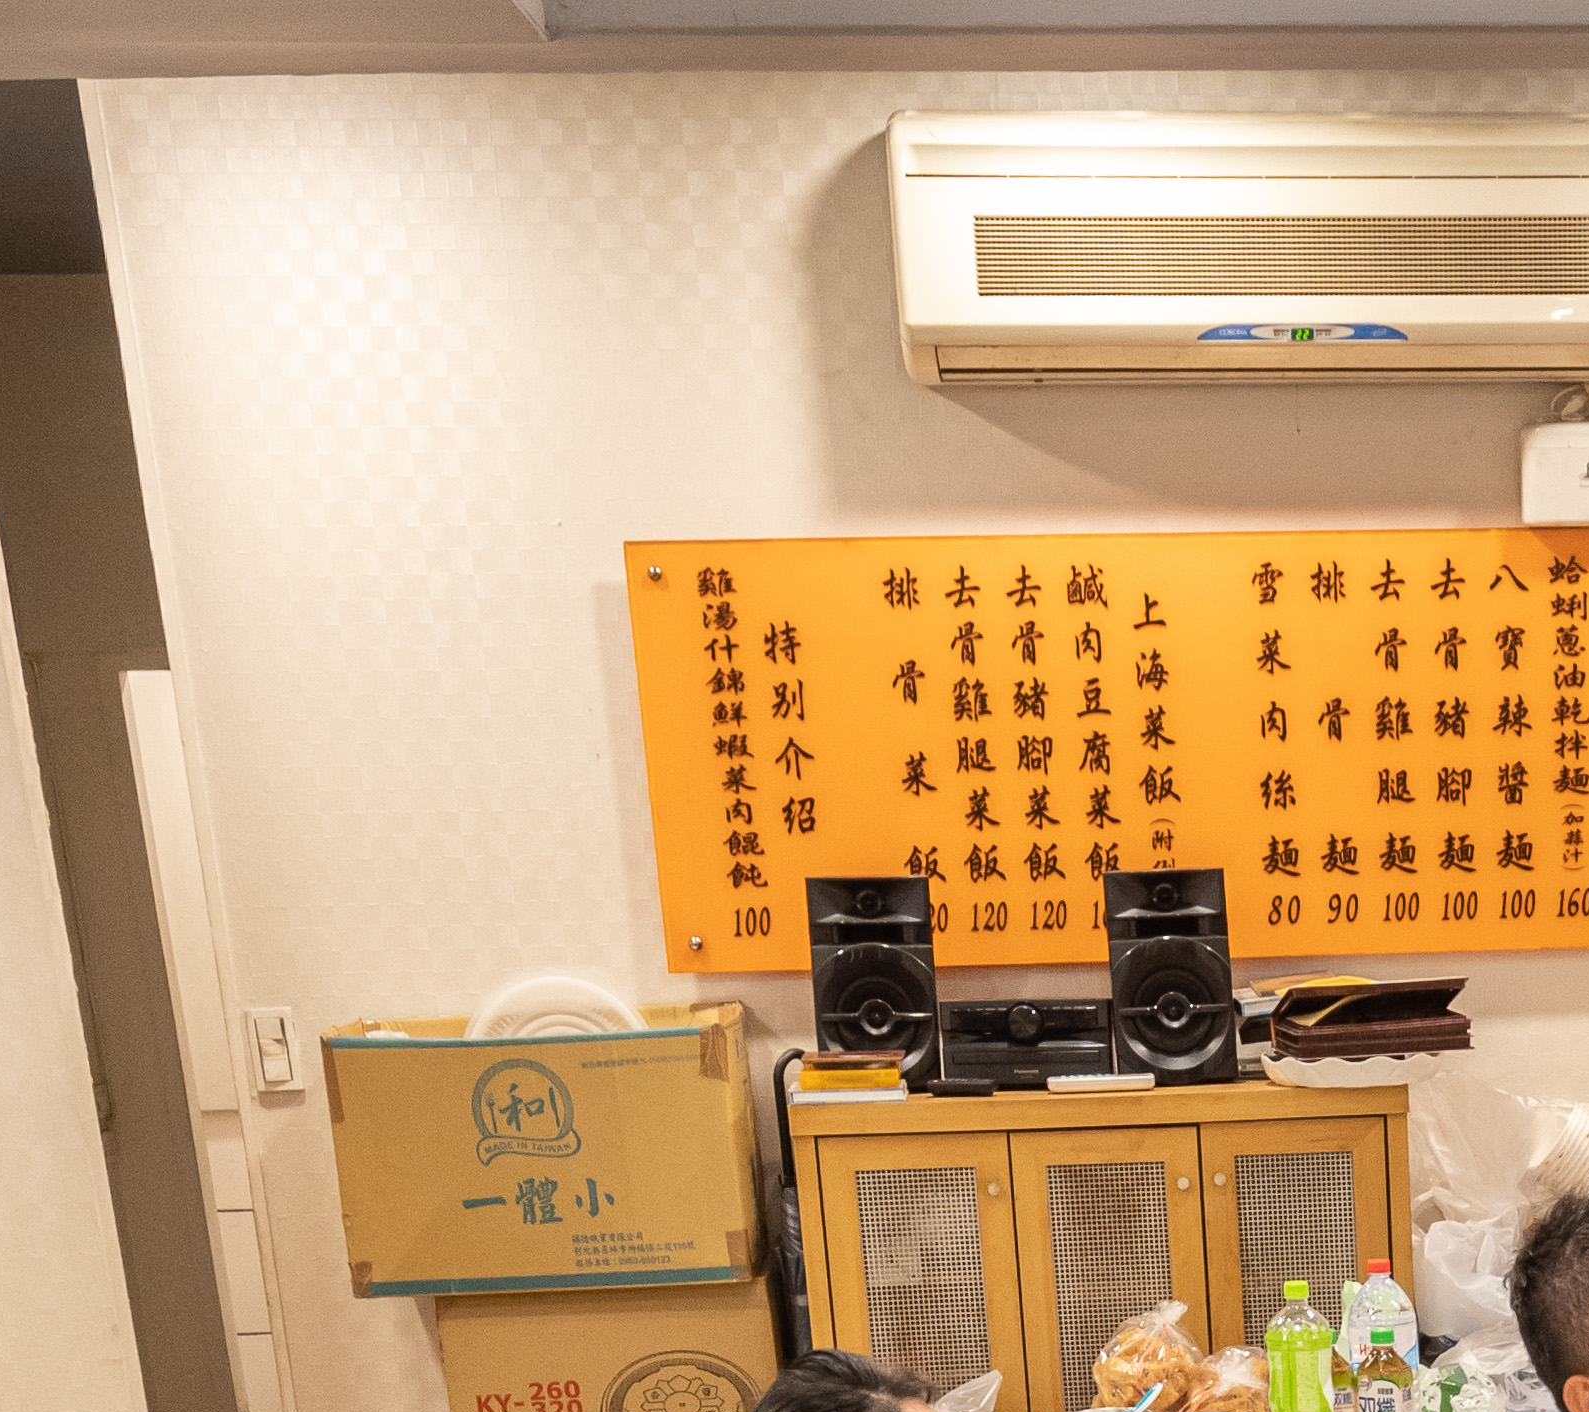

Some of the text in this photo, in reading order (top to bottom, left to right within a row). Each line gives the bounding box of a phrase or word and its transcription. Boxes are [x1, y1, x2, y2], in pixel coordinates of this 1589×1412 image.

[882, 566, 947, 883] 排骨菜飯
[944, 565, 1008, 884] 去骨雞腿菜飯
[1309, 560, 1361, 877] 排骨麵
[1369, 557, 1419, 875] 去骨雞腿麵
[971, 901, 1008, 933] 120
[1029, 899, 1068, 932] 120
[1267, 894, 1302, 926] 80
[1326, 892, 1360, 924] 90
[1382, 891, 1420, 923] 100
[1441, 889, 1479, 922] 100
[1498, 888, 1537, 920] 100
[733, 906, 772, 938] 100
[498, 1082, 546, 1133] 和
[484, 1140, 572, 1155] MADE IN TAIWAN
[461, 1175, 615, 1226] 一體小
